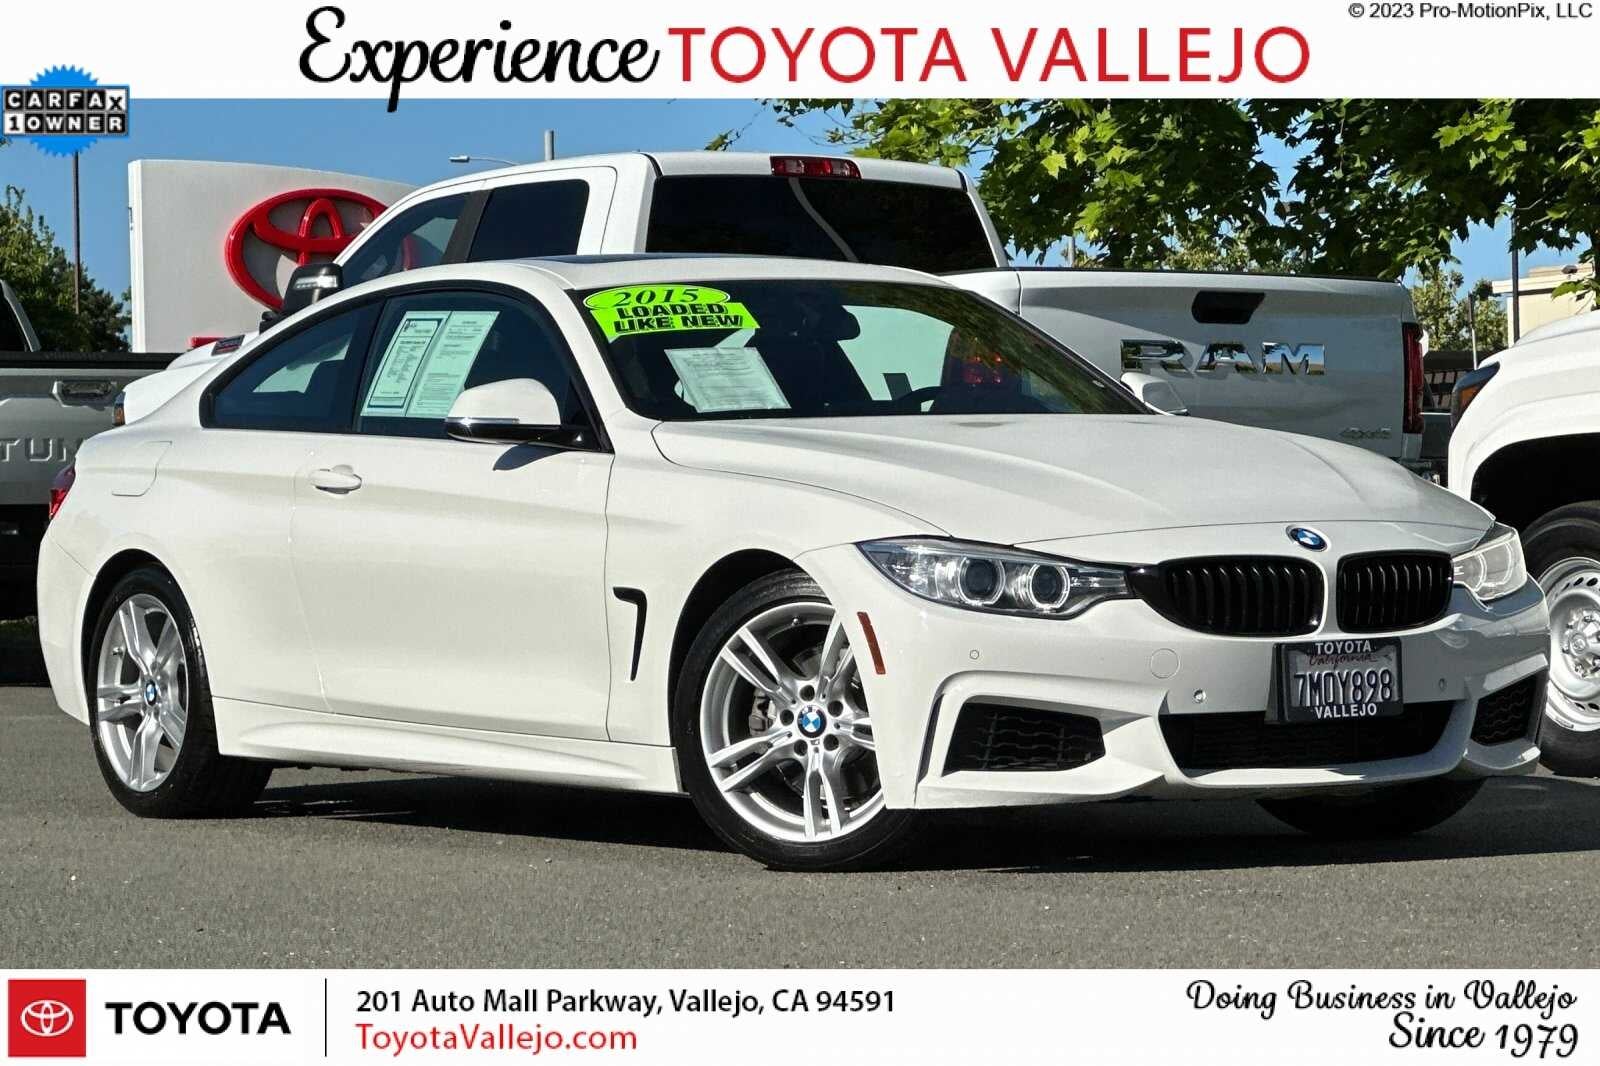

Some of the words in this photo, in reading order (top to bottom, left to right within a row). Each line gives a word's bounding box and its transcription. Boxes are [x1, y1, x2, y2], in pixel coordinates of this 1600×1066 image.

[614, 288, 699, 308] 2015
[617, 303, 728, 319] LOADED
[613, 316, 674, 333] LIKE
[682, 314, 743, 328] NEW
[1120, 340, 1326, 375] RAM
[1315, 640, 1372, 655] TOYOTA
[1294, 667, 1393, 704] 7MOY898
[1315, 702, 1377, 719] VALLEJO
